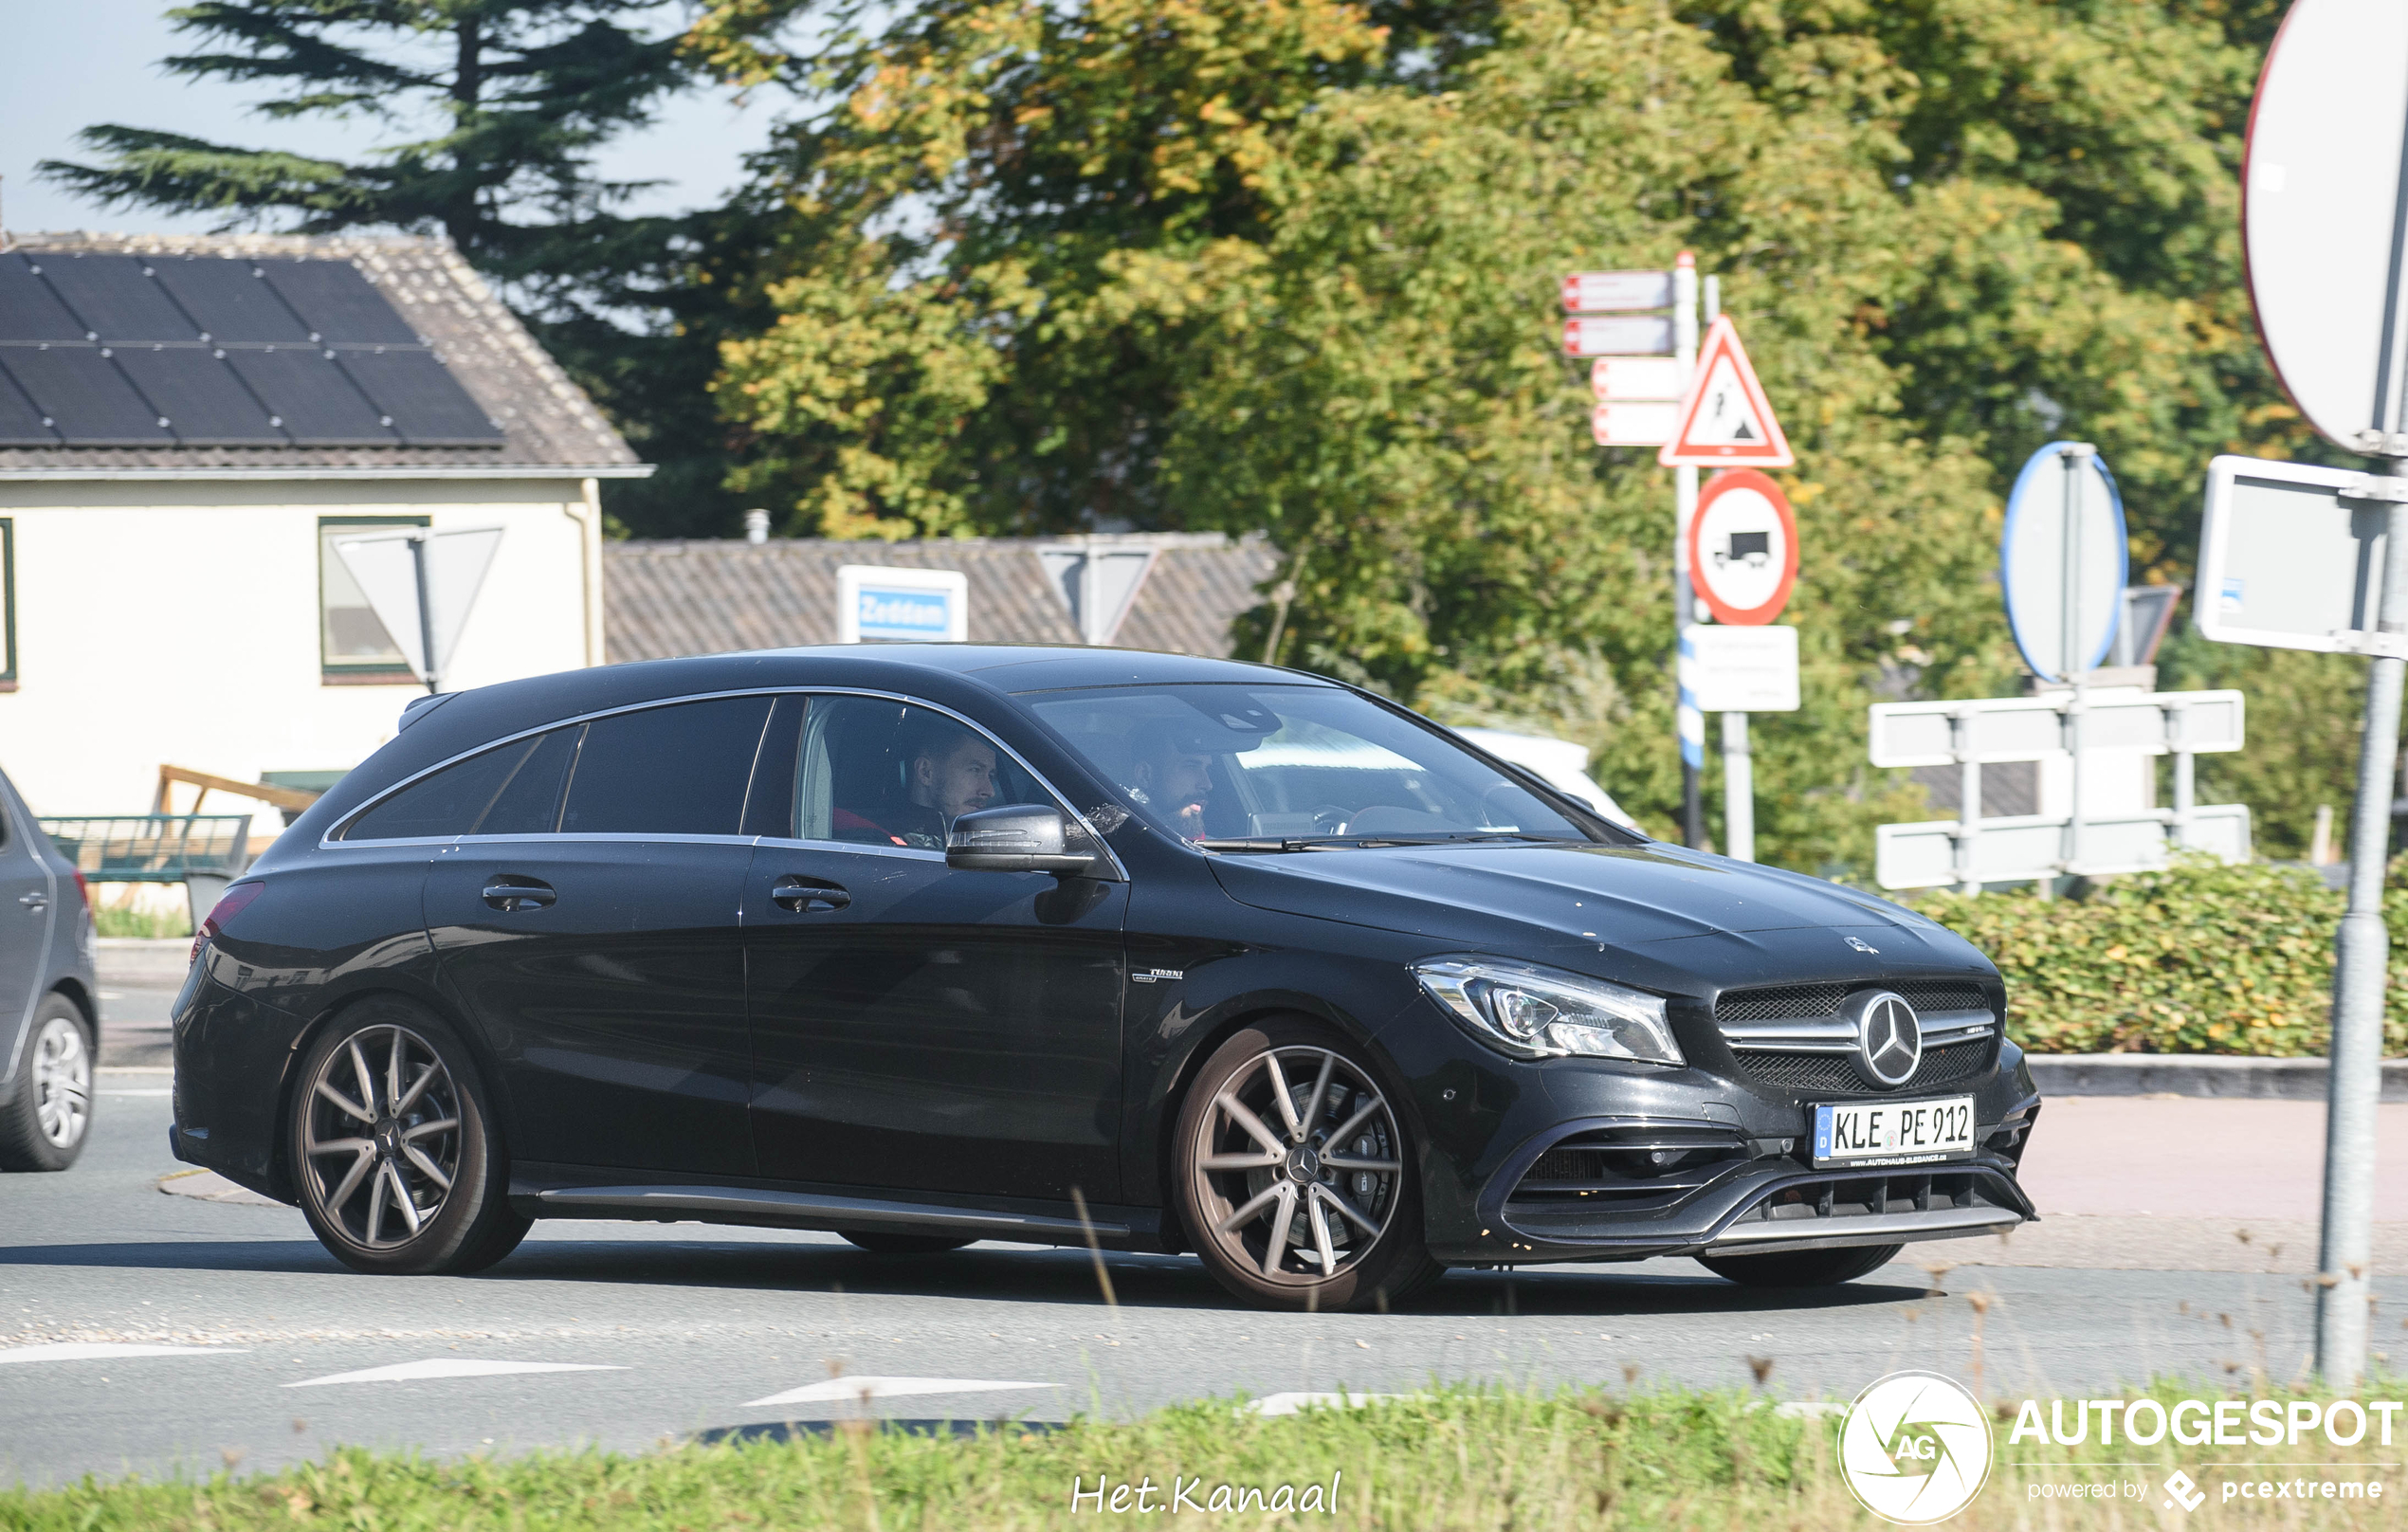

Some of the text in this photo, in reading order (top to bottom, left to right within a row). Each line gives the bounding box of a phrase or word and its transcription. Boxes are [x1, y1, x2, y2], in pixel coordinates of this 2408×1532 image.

[861, 595, 943, 626] Zeddam
[1819, 1104, 1968, 1149] D KLE PE 912
